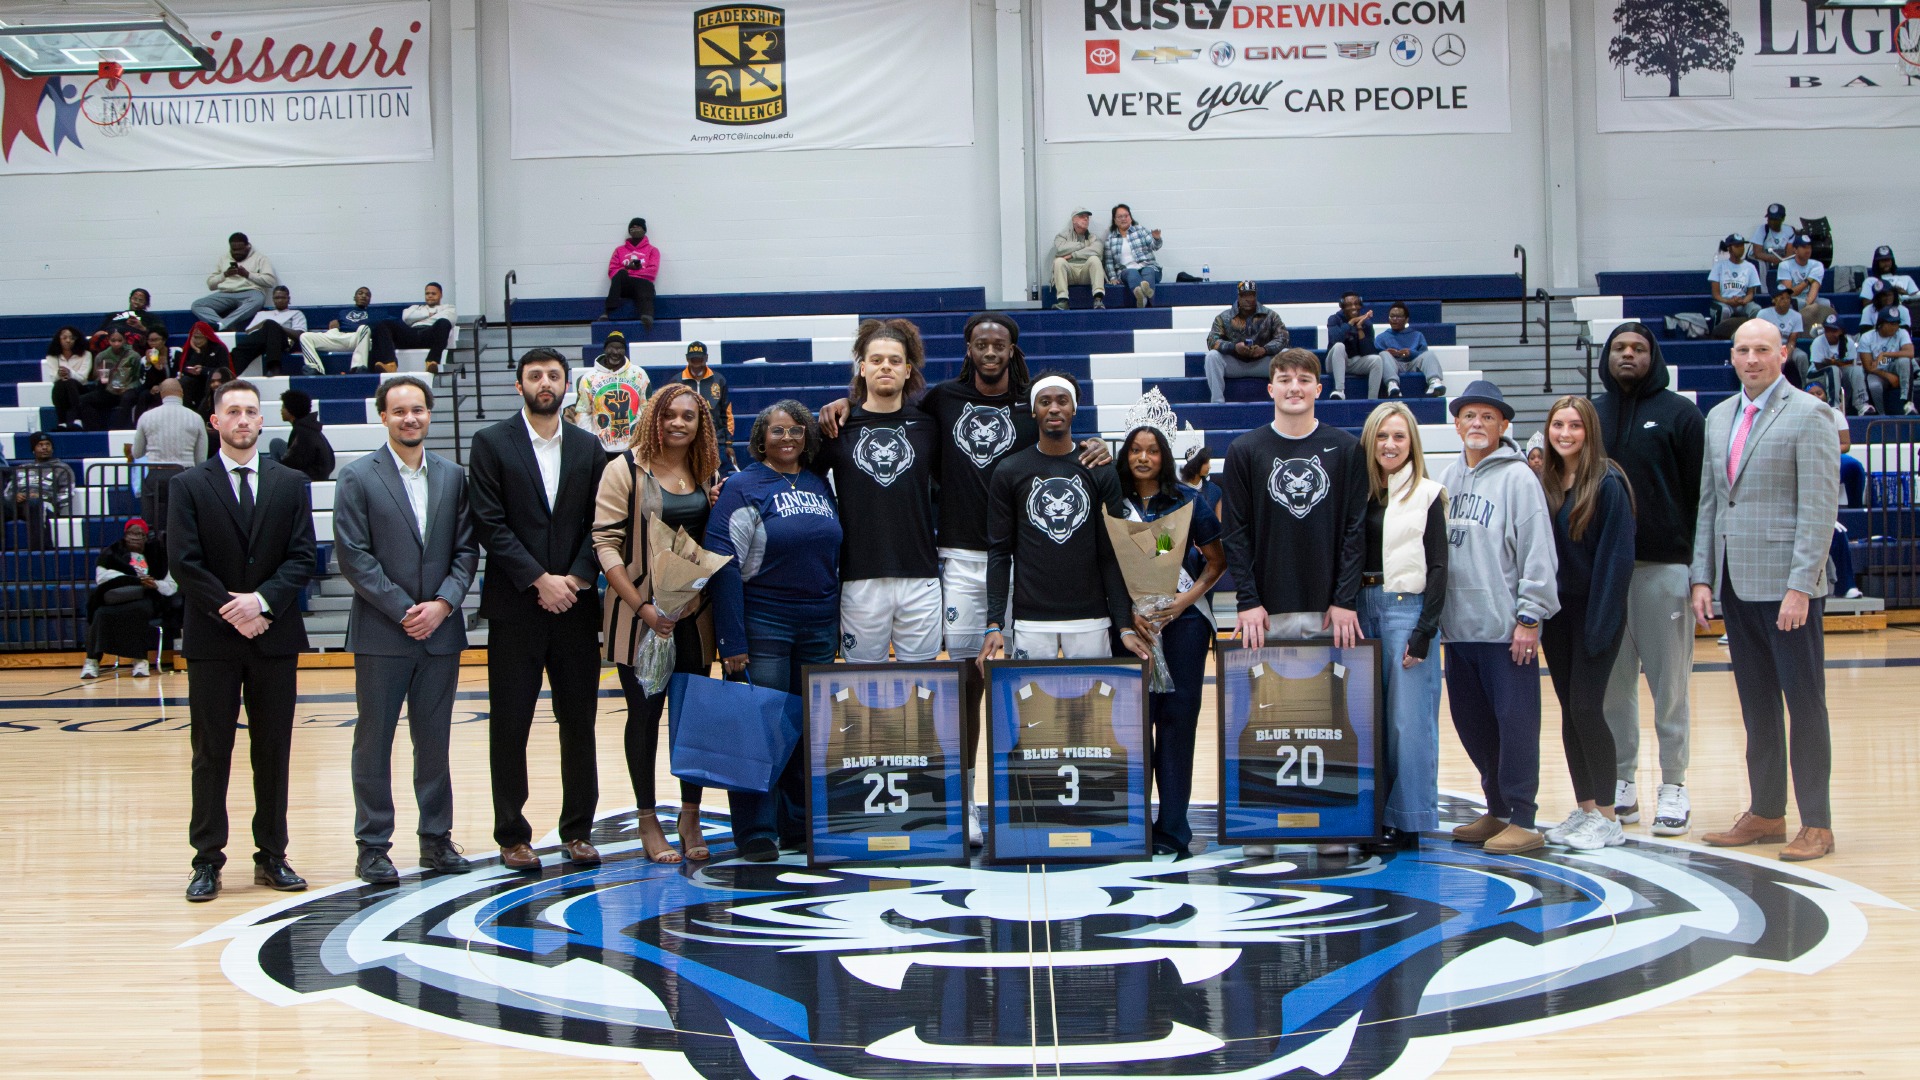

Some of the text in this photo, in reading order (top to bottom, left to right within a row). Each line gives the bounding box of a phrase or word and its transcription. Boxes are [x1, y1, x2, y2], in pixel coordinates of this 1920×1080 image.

[700, 9, 780, 27] LEADERSHIP
[1244, 44, 1328, 61] GMC
[286, 92, 411, 122] COALITION
[703, 101, 781, 120] EXCELLENCE
[1087, 79, 1468, 132] WE'RE your CAR PEOPLE
[690, 131, 794, 144] ArmyROTC@lincolnu.edu
[773, 490, 834, 513] LINCOLN
[781, 506, 834, 519] UNIVERSITY
[1255, 728, 1342, 741] BLUE TIGERS
[842, 755, 928, 769] BLUE TIGERS
[1023, 746, 1112, 760] BLUE TIGERS
[1276, 745, 1325, 787] 20
[863, 773, 909, 814] 25
[1057, 764, 1080, 806] 3
